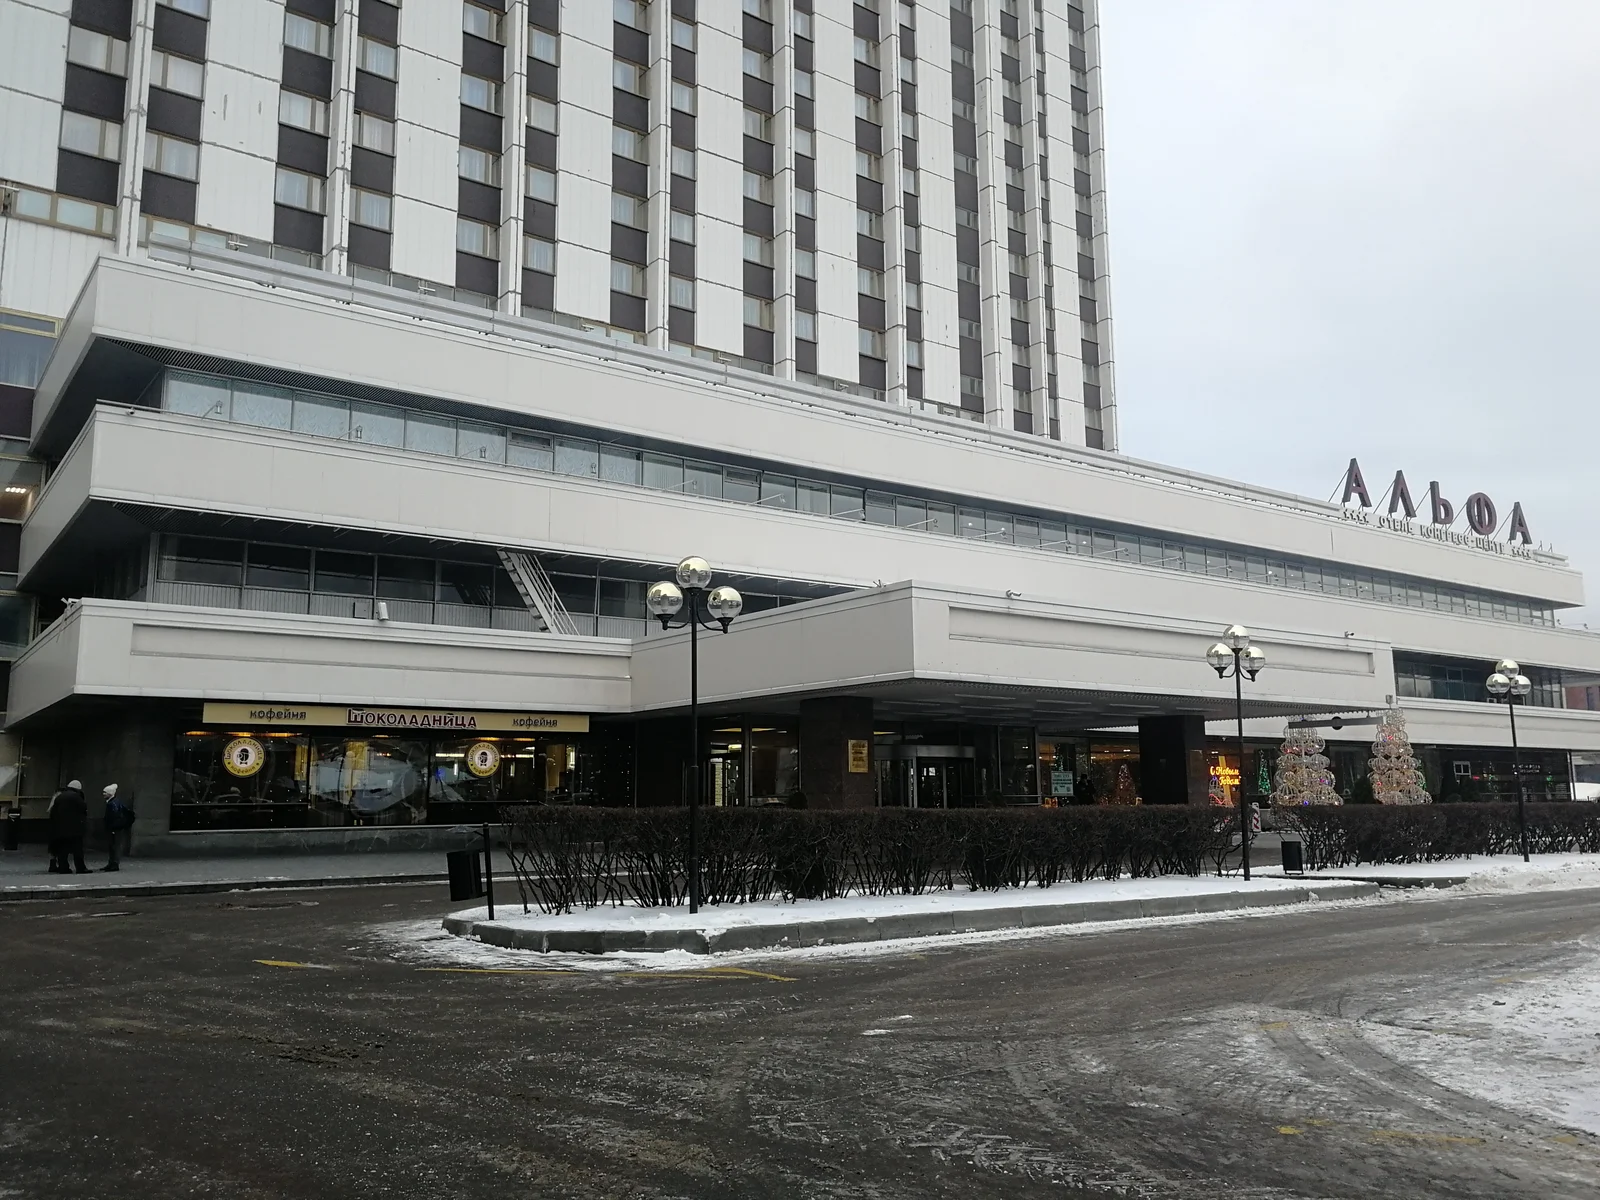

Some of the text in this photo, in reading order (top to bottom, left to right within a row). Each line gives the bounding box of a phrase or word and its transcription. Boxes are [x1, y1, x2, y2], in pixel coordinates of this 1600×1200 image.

[1342, 457, 1533, 545] АЛЬФА
[1378, 515, 1415, 536] ОТЕЛЬ
[249, 708, 558, 729] кофейня ШОКОЛАДНИЦА кофейня
[224, 739, 263, 761] ШОКОЛАДНИЦА
